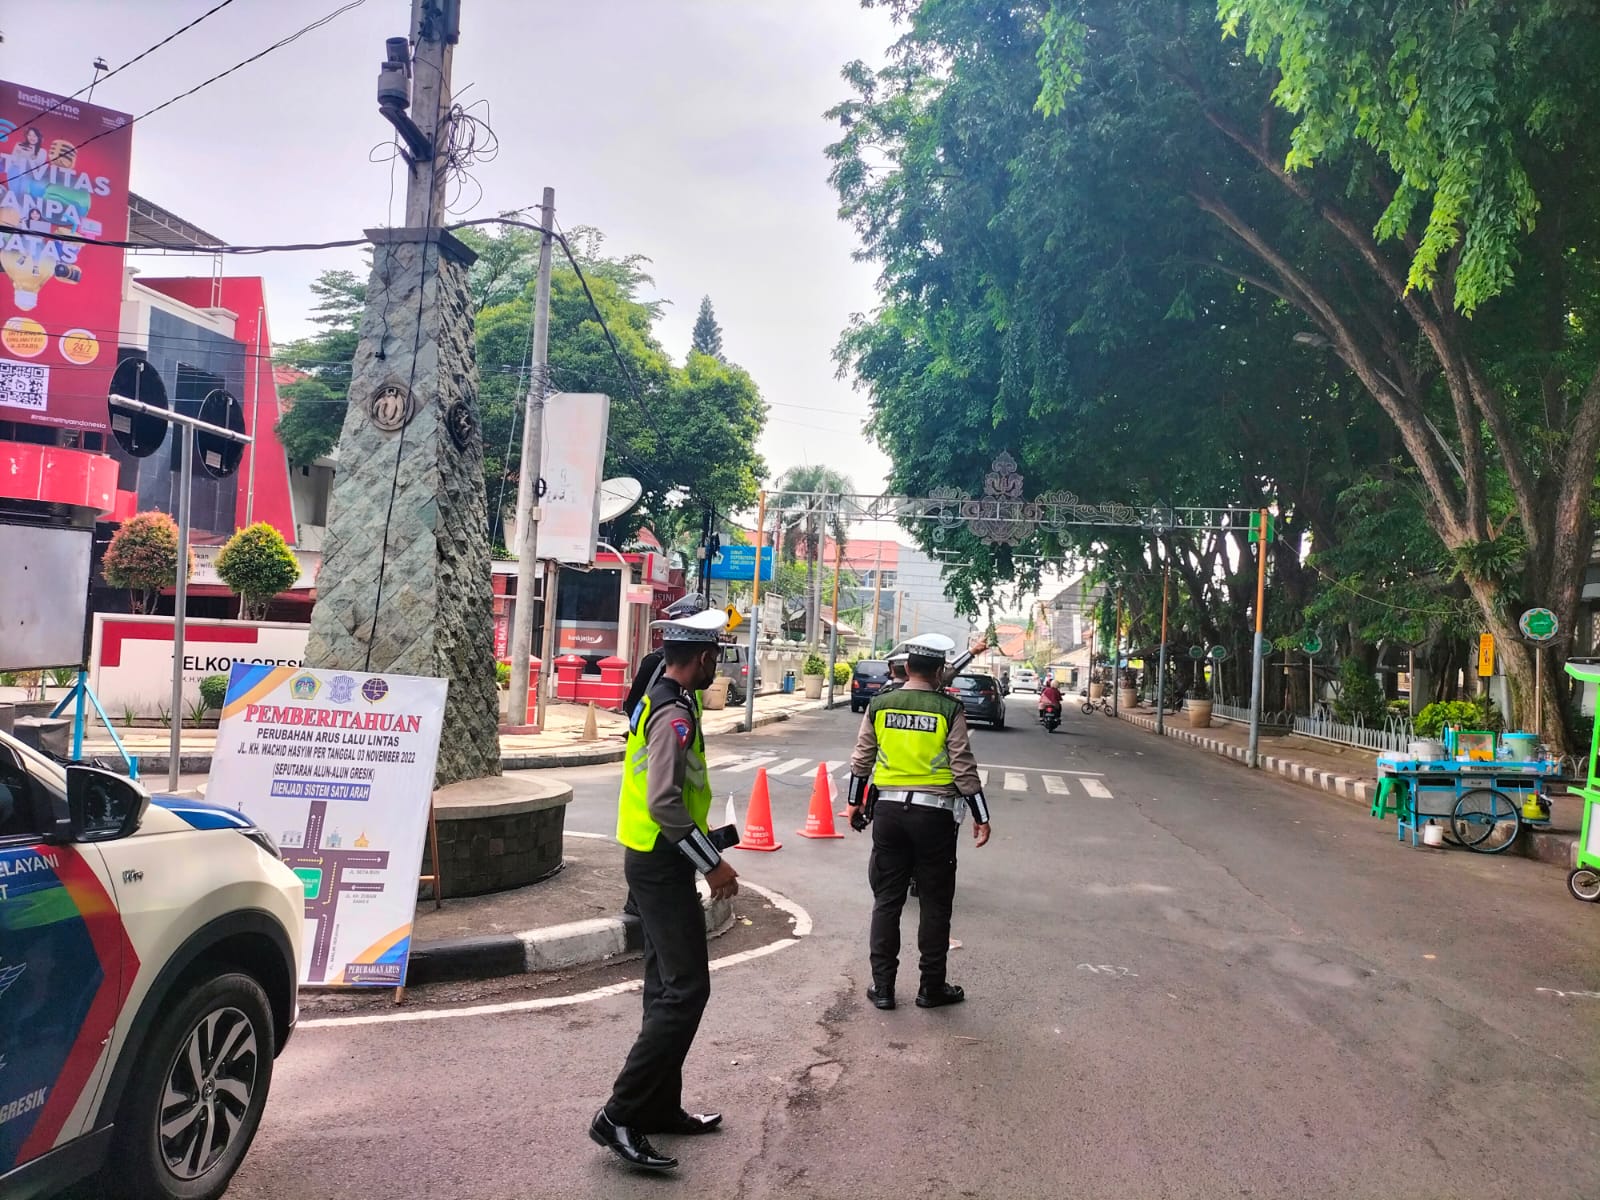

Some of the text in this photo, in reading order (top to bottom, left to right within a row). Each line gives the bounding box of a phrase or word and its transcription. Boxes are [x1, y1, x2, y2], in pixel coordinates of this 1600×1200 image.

[17, 91, 80, 115] IndiHome
[243, 703, 423, 734] PEMBERITAHUAN
[886, 713, 937, 732] POLISI
[256, 727, 400, 748] PERUBAHAN ARUS LALU LINTAS
[237, 741, 416, 764] JL. KH. WACHID HASYIM PER TANGGAL 03 NOVEMBER 2022
[272, 762, 376, 783] (SEPUTARAN ALUN-ALUN GRESIK)
[272, 781, 371, 799] MENJADI SISTEM SATU ARAH
[347, 963, 401, 975] PERUBAHAN ARUS
[0, 1085, 48, 1125] GRESIK
